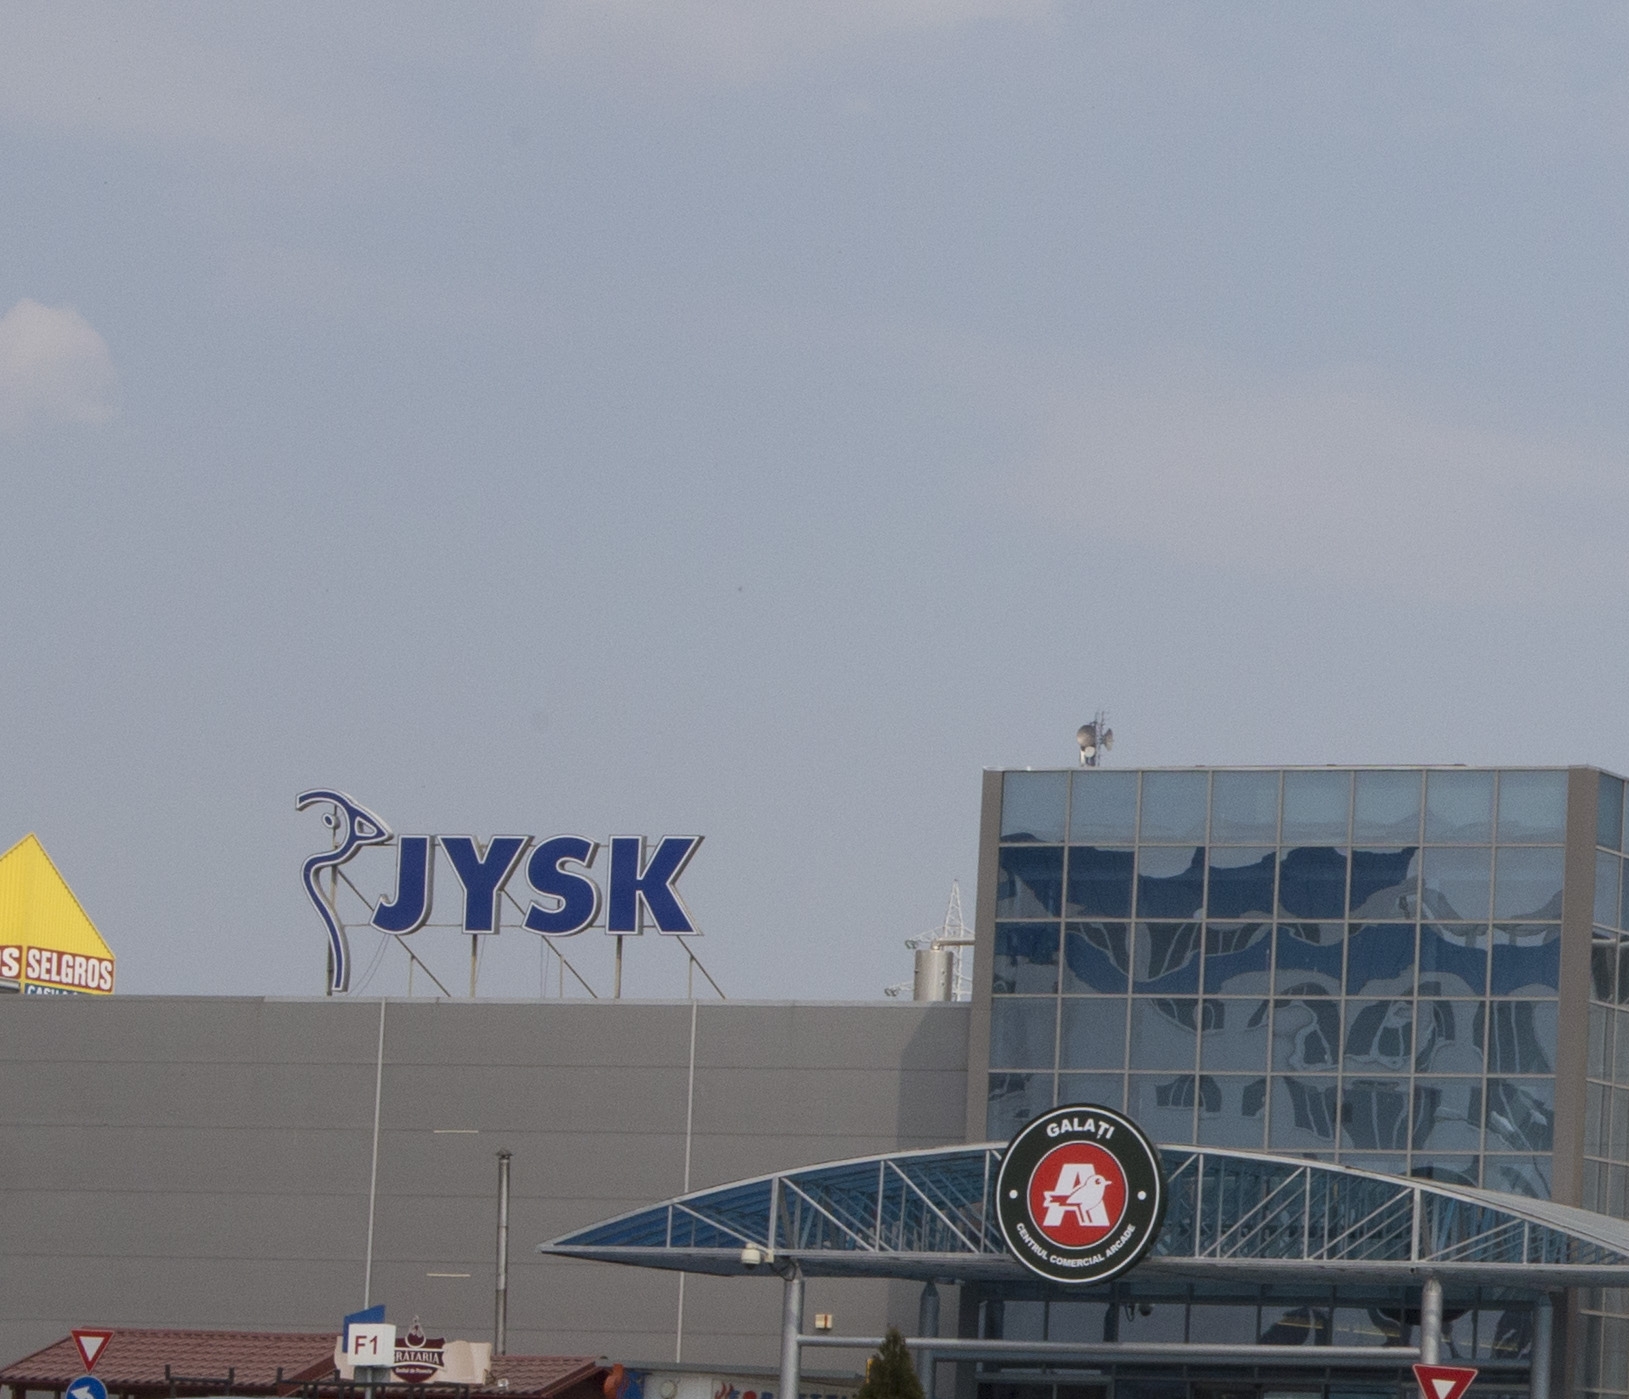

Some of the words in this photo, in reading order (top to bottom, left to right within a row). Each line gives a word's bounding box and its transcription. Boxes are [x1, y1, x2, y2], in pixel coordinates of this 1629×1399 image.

[370, 834, 705, 936] JYSK
[27, 949, 112, 990] SELGROS
[1016, 1222, 1048, 1260] CENTRUL
[1050, 1254, 1105, 1267] COMERCIAL
[1106, 1223, 1136, 1257] ARCADE
[354, 1335, 378, 1355] F1
